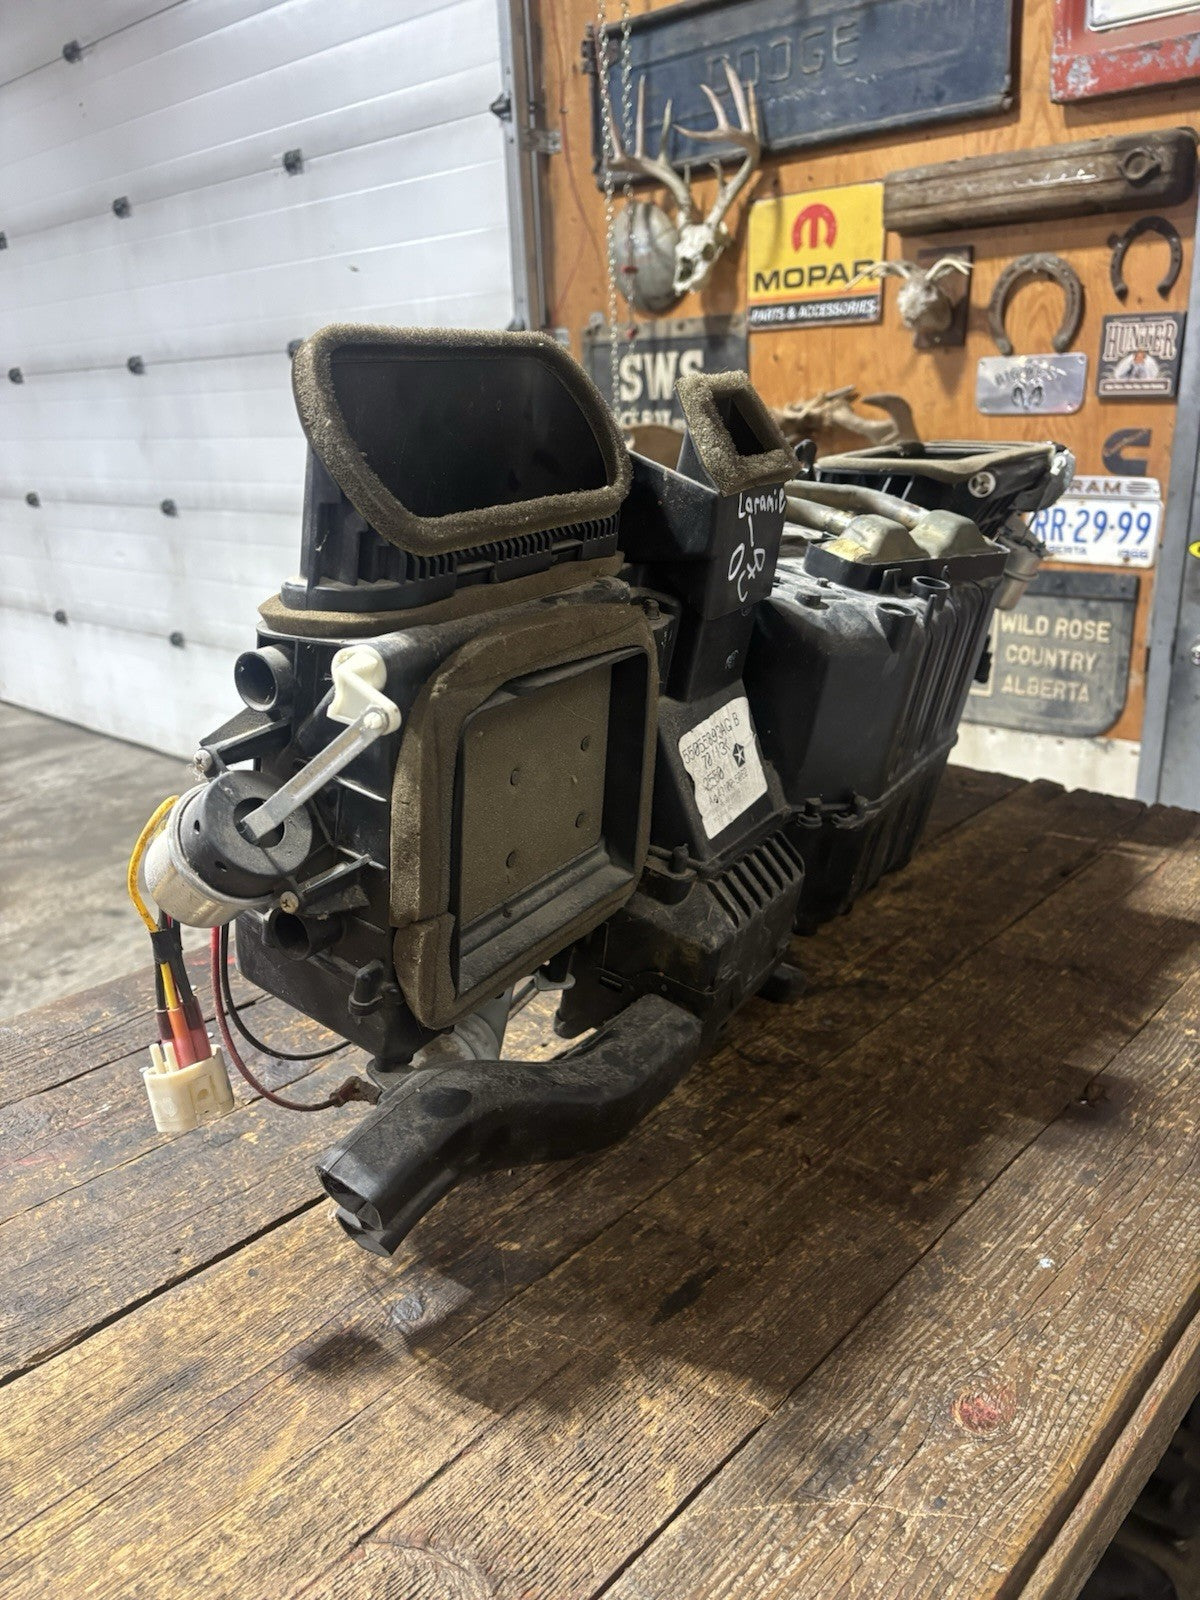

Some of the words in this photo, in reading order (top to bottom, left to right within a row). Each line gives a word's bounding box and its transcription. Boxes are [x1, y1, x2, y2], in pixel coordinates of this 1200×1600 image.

[1102, 320, 1178, 361] HUNTER
[1067, 480, 1122, 493] RAM
[1000, 614, 1049, 637] WILD
[1054, 618, 1112, 643] ROSE
[1005, 644, 1098, 672] COUNTRY
[1000, 674, 1091, 703] ALBERTA
